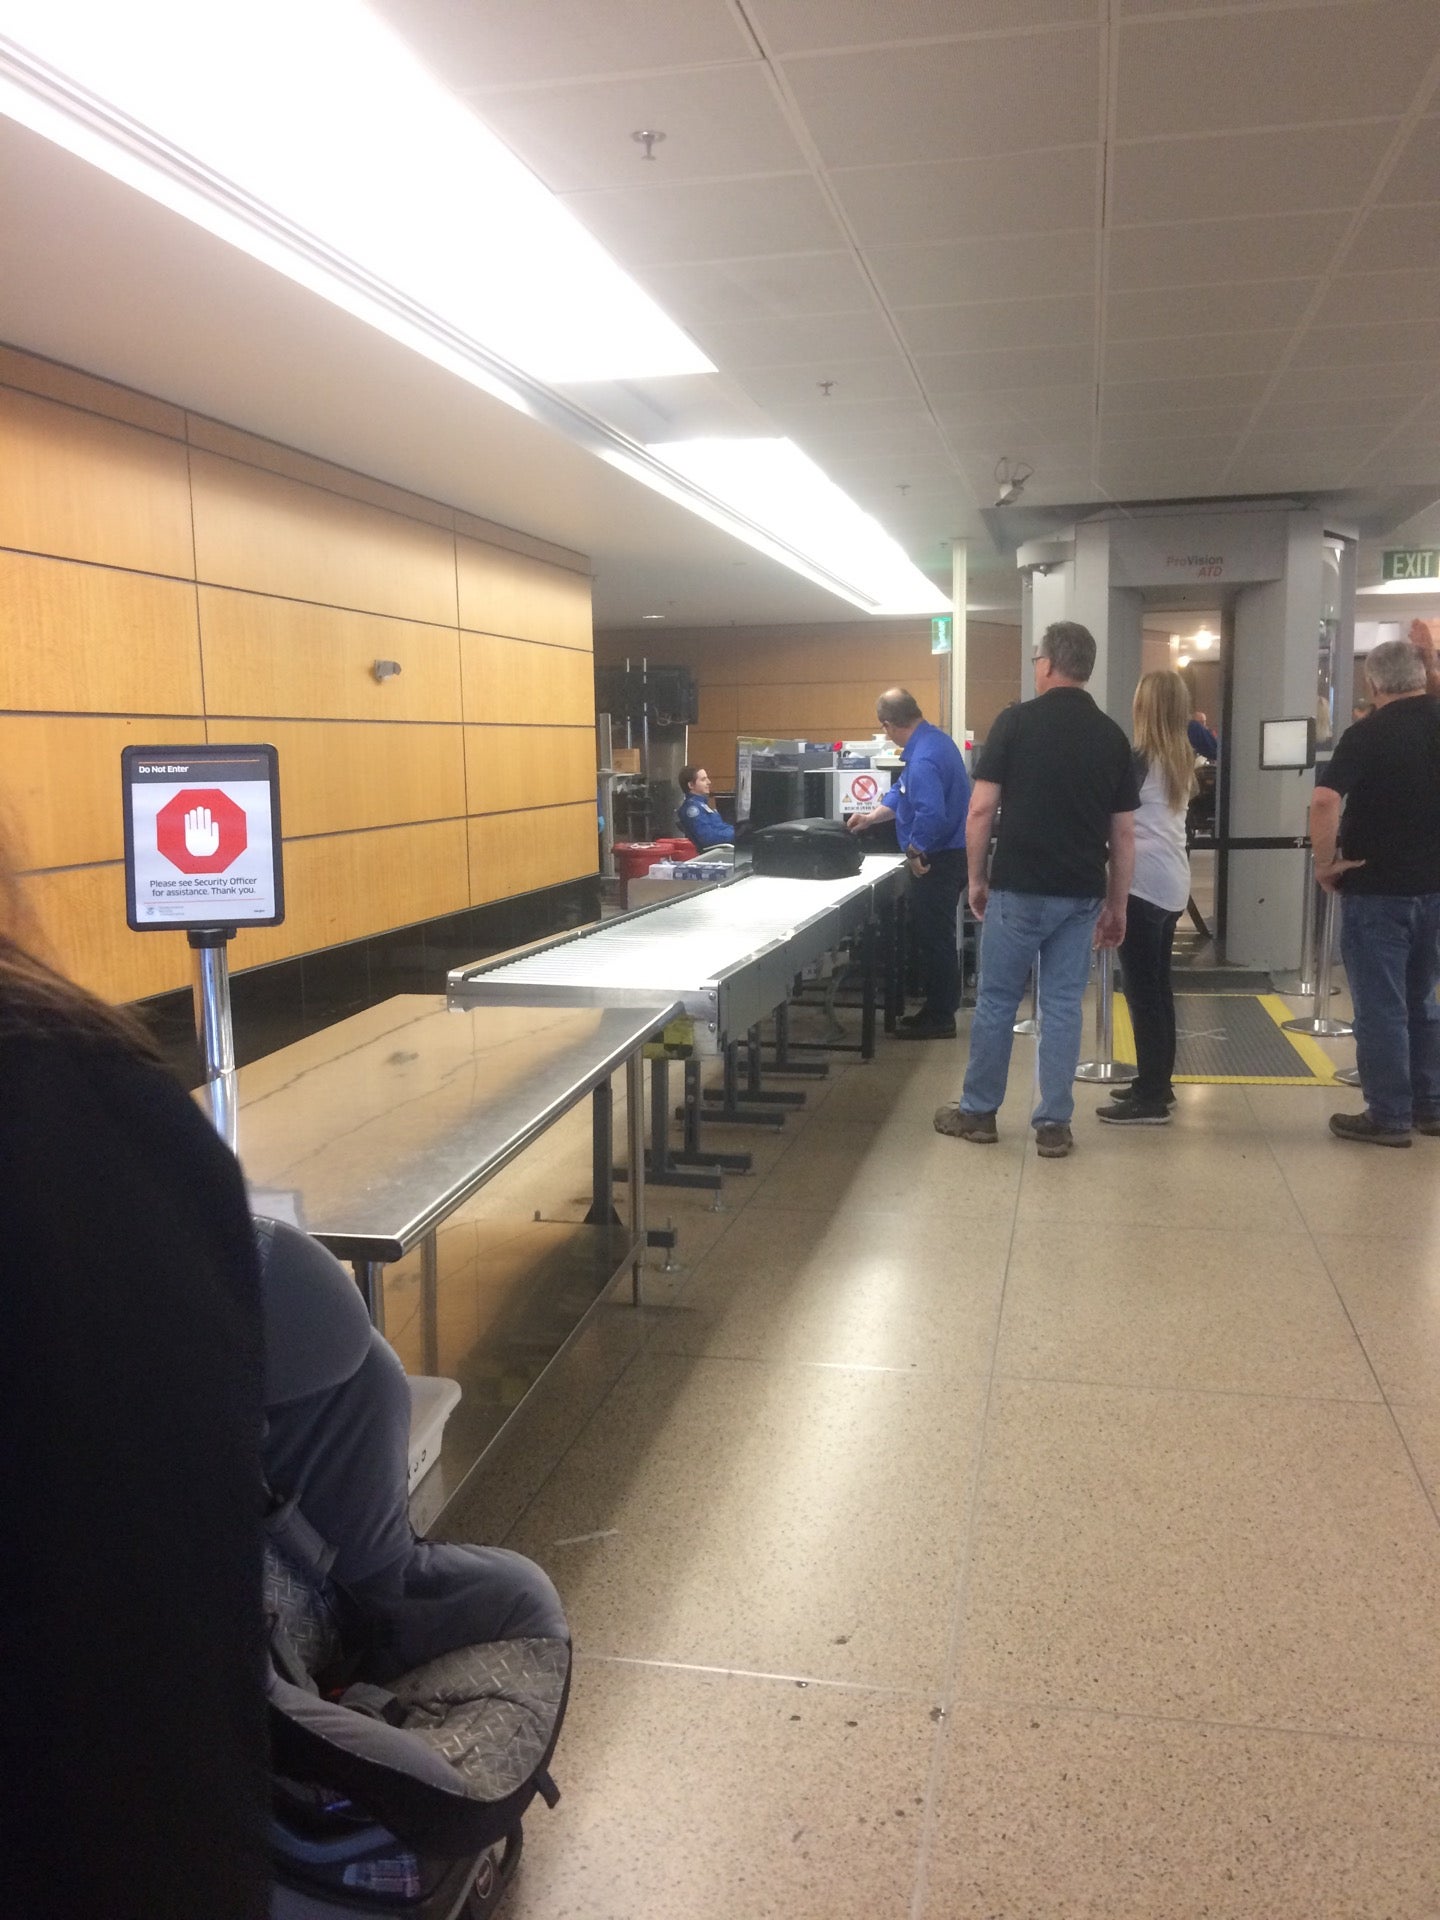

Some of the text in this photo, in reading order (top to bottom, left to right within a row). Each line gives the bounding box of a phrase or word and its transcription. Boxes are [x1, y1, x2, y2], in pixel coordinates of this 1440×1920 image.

[1167, 555, 1224, 566] ProVision
[1392, 551, 1433, 577] EXIT
[1198, 566, 1223, 577] ATD
[167, 765, 189, 773] Enter
[150, 880, 177, 888] Please
[194, 878, 228, 887] Security
[229, 877, 257, 885] Officer
[152, 887, 255, 897] for assistance. Thank you.
